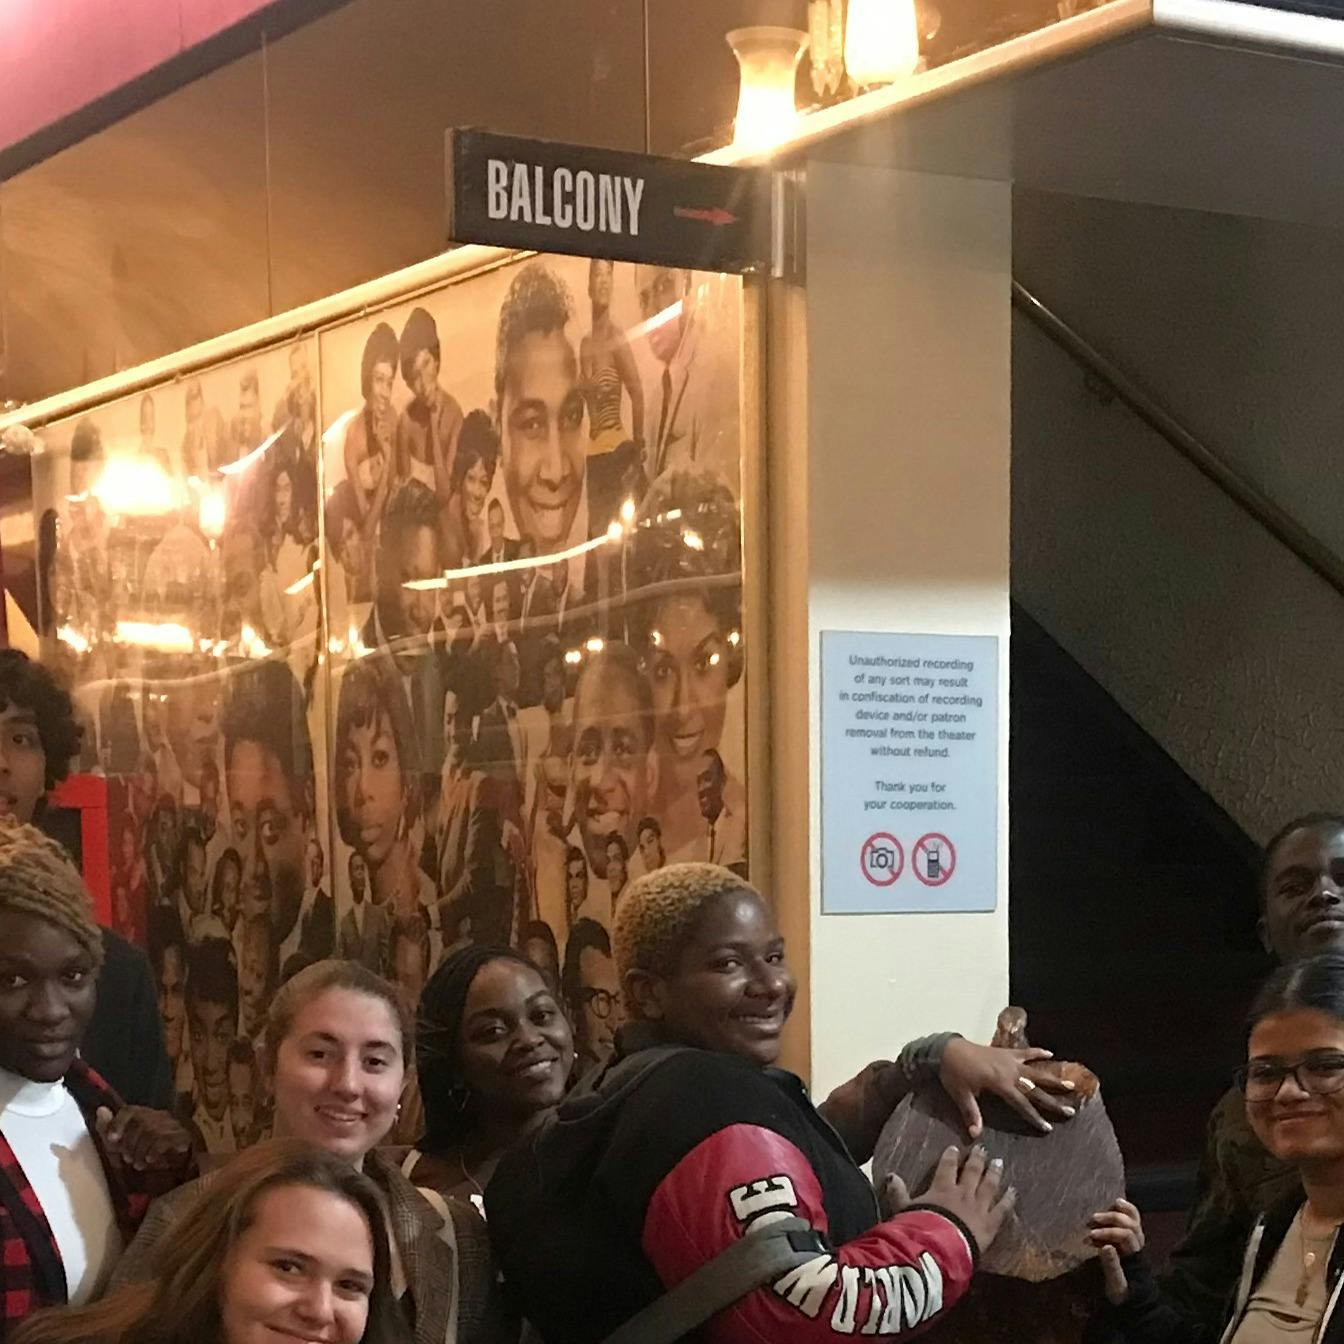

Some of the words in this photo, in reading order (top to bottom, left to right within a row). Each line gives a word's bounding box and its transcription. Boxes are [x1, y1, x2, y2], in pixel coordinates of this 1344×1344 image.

[487, 158, 645, 236] BALCONY
[849, 655, 920, 668] Unauthorized
[923, 659, 974, 672] recording
[854, 673, 865, 684] of
[868, 675, 886, 686] any
[890, 675, 910, 686] sort
[913, 677, 935, 688] may
[938, 677, 968, 687] result
[839, 691, 849, 701] in
[851, 691, 915, 704] confiscation
[918, 693, 929, 704] of
[931, 695, 983, 707] recording
[855, 709, 889, 721] device
[893, 710, 928, 722] and/or
[931, 712, 966, 723] patron
[845, 728, 887, 738] removal
[890, 728, 915, 739] from
[918, 729, 935, 740] the
[938, 729, 976, 741] theater
[870, 746, 911, 757] without
[913, 746, 950, 758] refund.
[875, 780, 905, 792] Thank
[909, 783, 928, 794] you
[931, 781, 947, 792] for
[864, 800, 887, 811] your
[889, 799, 956, 811] cooperation.
